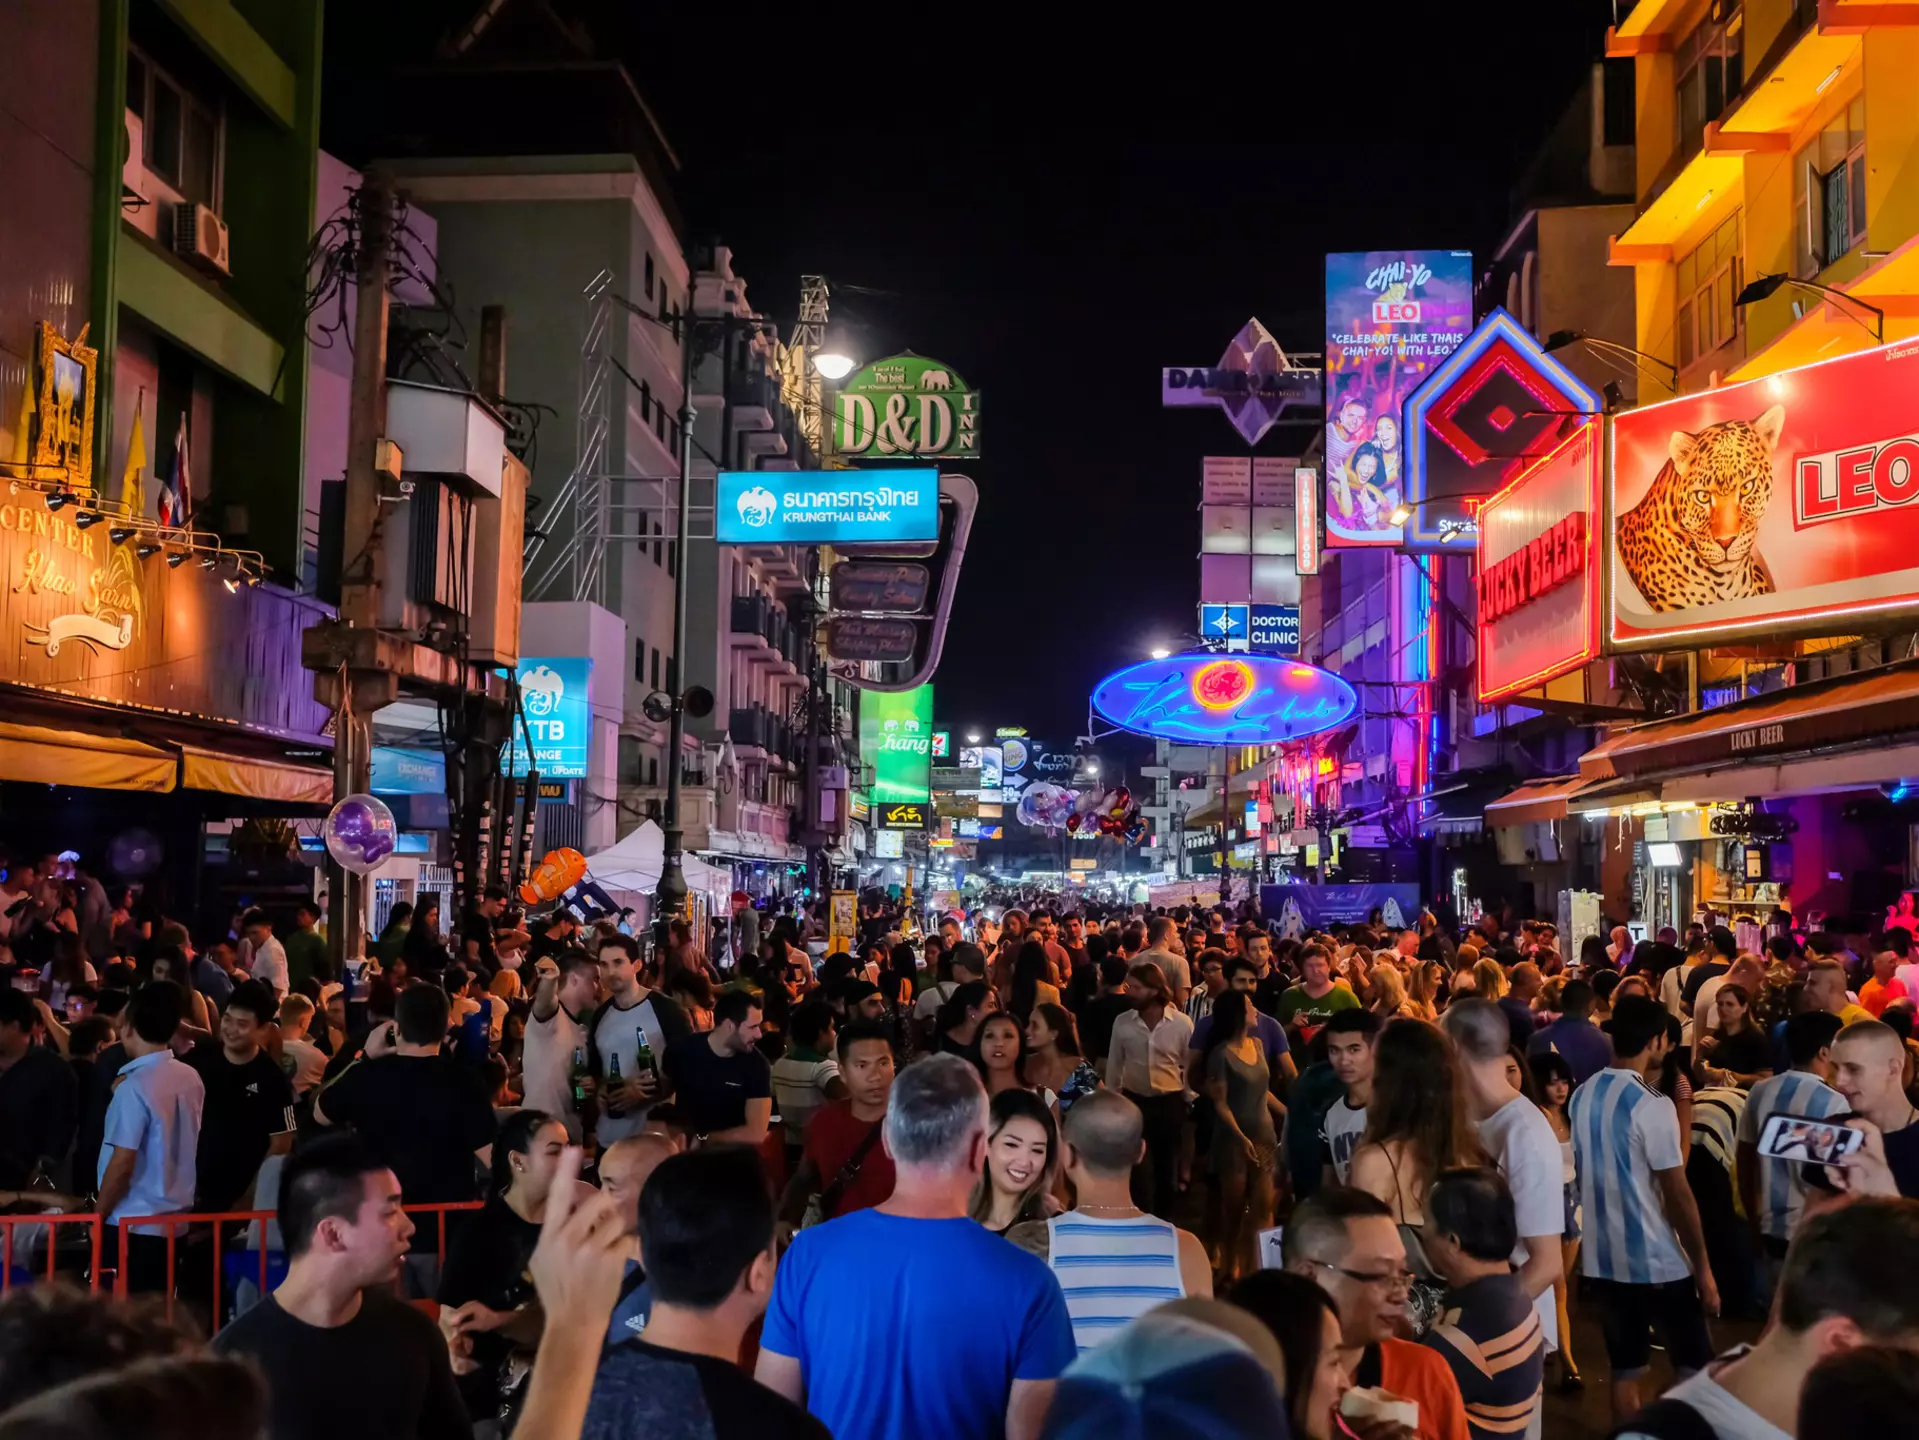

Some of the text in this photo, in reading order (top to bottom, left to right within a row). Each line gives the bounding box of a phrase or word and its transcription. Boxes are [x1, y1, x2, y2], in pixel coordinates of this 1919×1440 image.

[1365, 261, 1432, 292] CHAI-YO
[1375, 304, 1418, 320] LEO
[1342, 345, 1394, 356] CHAI-YO!
[1399, 344, 1424, 356] WITH
[1404, 333, 1428, 343] LIKE
[840, 393, 952, 454] D&D
[959, 395, 977, 449] INN
[1801, 438, 1919, 521] LEO
[783, 487, 919, 512] ธนาคารกรุงไทย
[783, 511, 891, 522] KRUNGTHAI BANK
[0, 504, 95, 560] CENTER
[13, 547, 134, 614] Khao Sarn
[1477, 512, 1586, 626] LUCKY BEER
[1251, 616, 1299, 627] DOCTOR
[1251, 631, 1298, 644] CLINIC
[1123, 671, 1338, 725] The Club
[515, 719, 565, 741] KTB
[1731, 725, 1784, 750] LUCKY BEER
[878, 732, 930, 755] Chang
[552, 766, 584, 776] UPDATE
